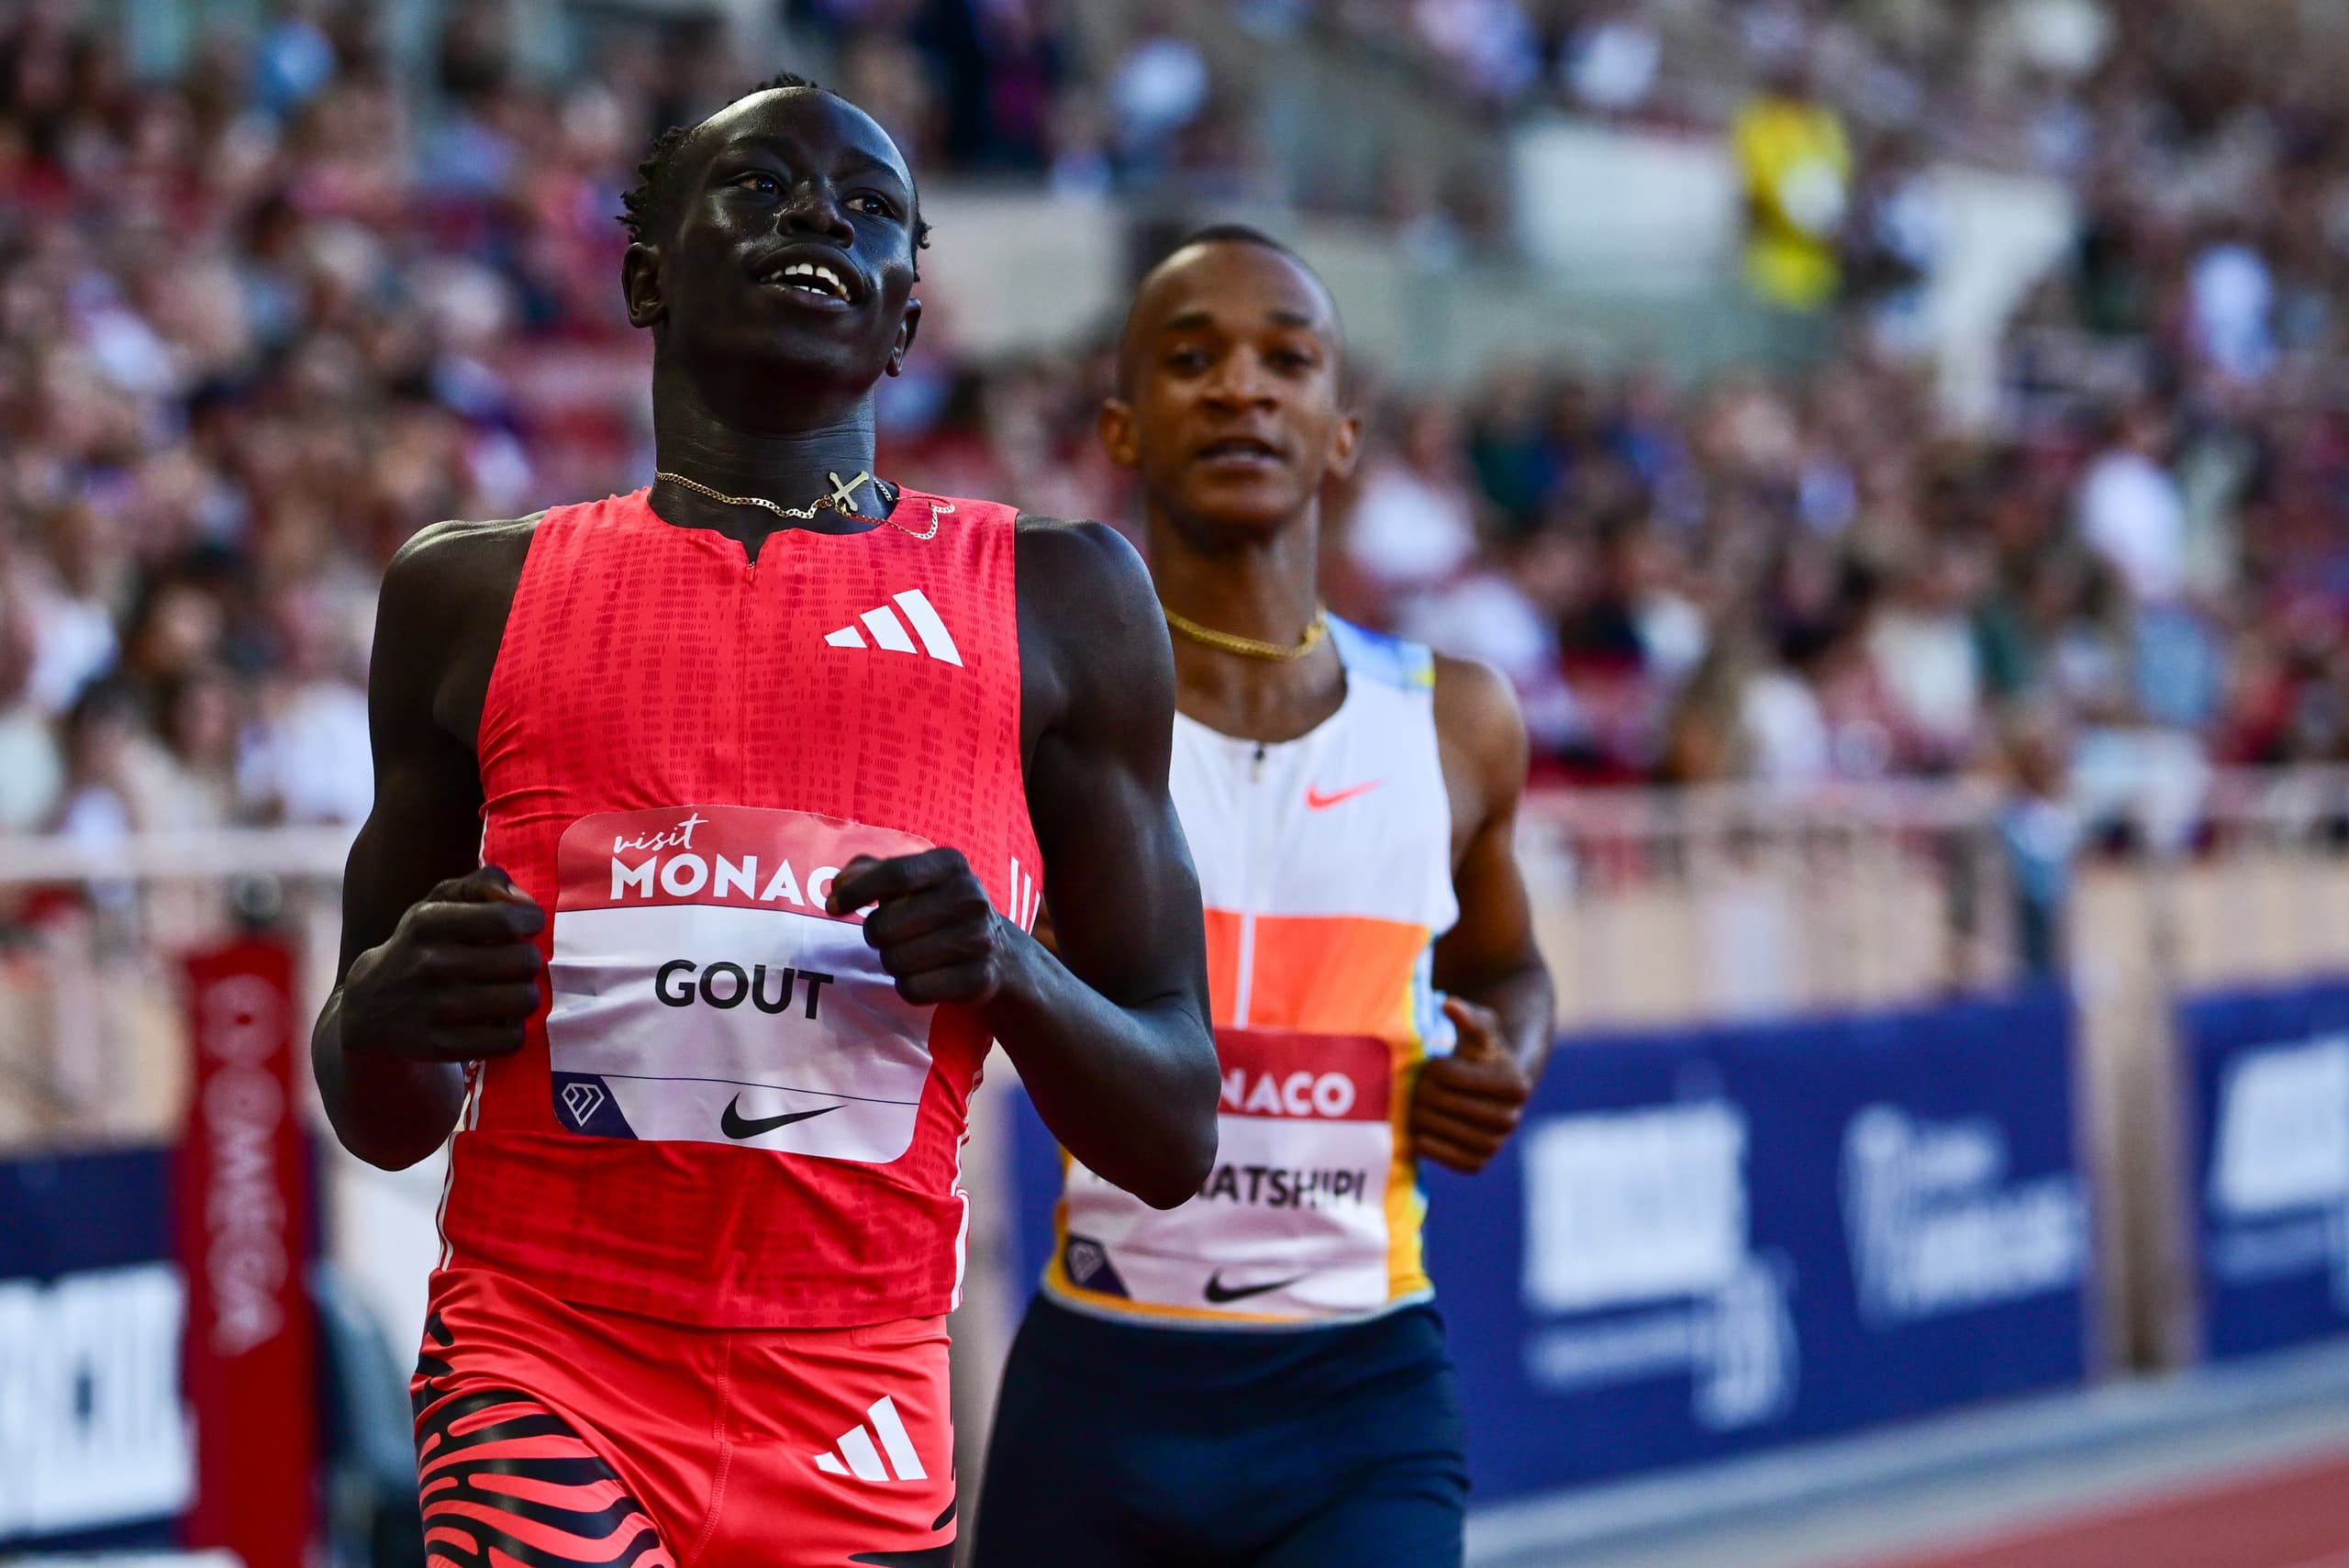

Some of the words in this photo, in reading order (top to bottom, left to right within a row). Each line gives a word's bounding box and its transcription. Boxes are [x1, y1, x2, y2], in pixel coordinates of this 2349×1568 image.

[614, 813, 708, 853] visit
[610, 853, 879, 917] MONAC
[655, 960, 833, 1019] GOUT
[1221, 1067, 1355, 1118] NACO
[1197, 1163, 1367, 1210] ATSHIPI
